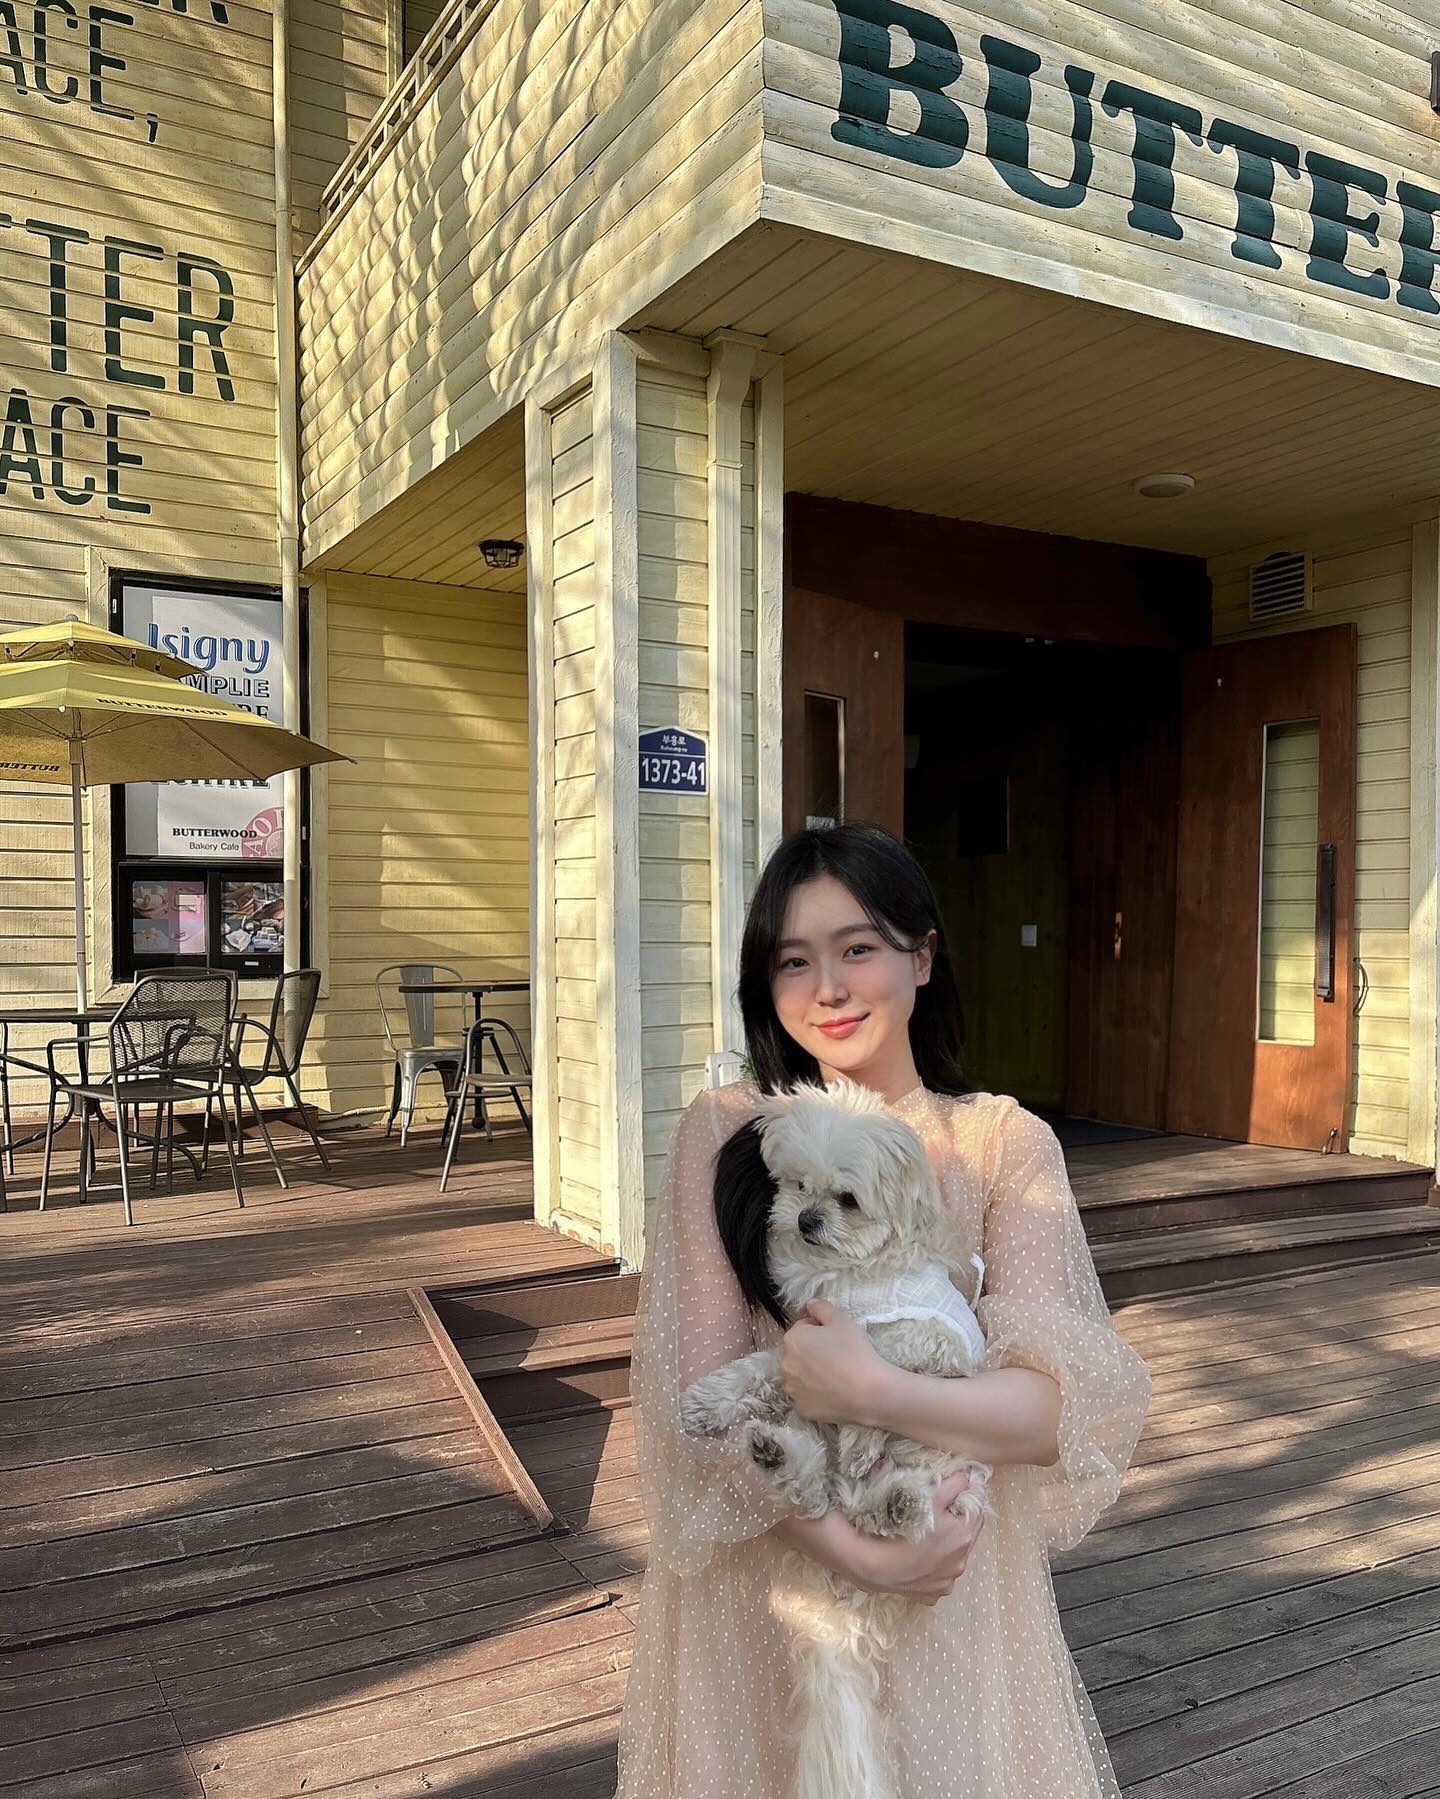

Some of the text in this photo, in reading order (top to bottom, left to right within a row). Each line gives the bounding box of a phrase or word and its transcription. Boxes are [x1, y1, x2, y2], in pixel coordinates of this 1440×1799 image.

[0, 213, 236, 402] TER
[148, 623, 270, 675] Isigny
[179, 675, 270, 698] MPLIE
[642, 757, 705, 786] 1373-41
[172, 828, 257, 838] BUTTERWOOD
[189, 842, 240, 852] Bakery Cafe
